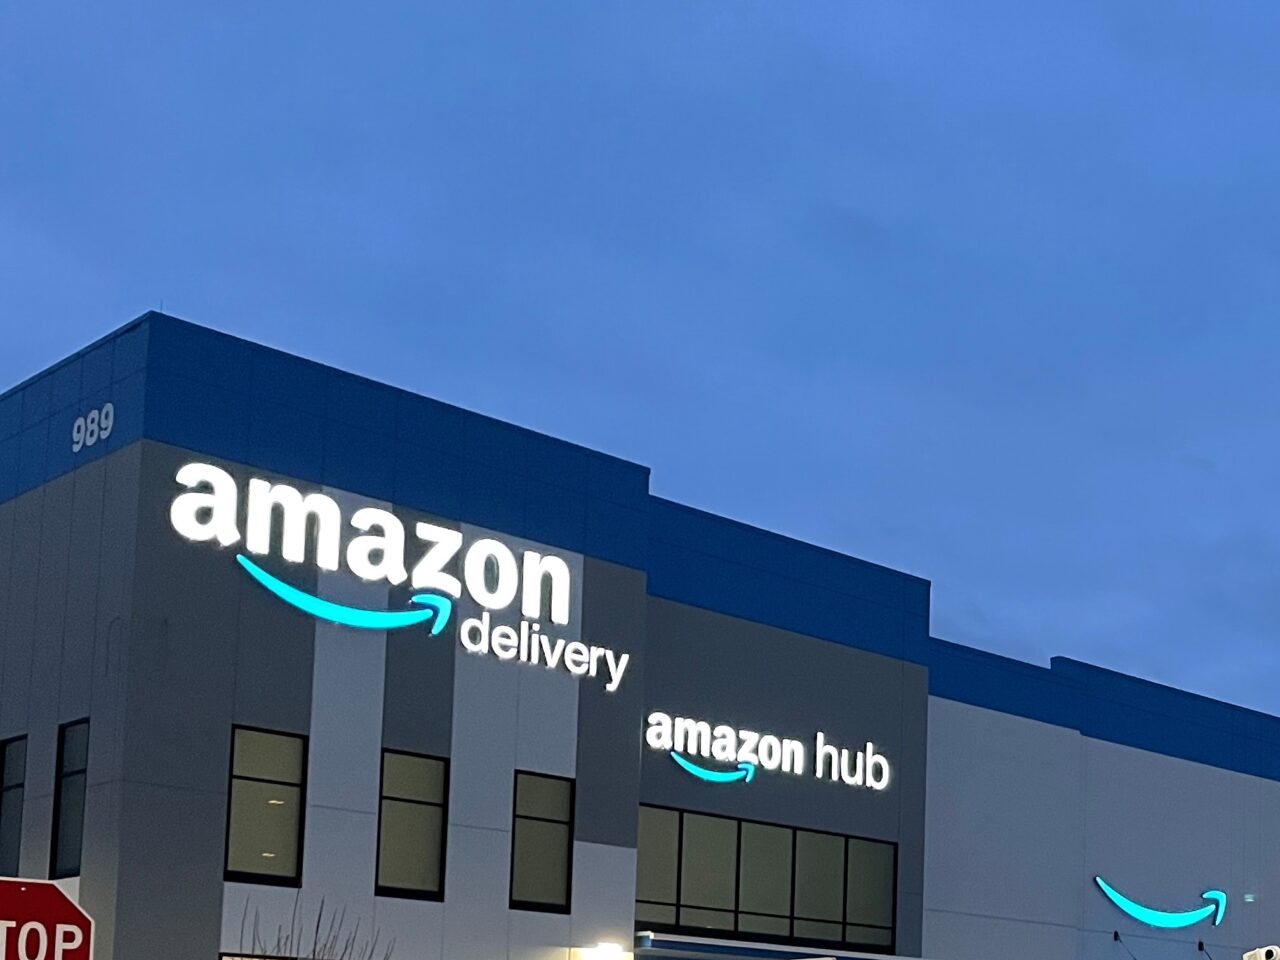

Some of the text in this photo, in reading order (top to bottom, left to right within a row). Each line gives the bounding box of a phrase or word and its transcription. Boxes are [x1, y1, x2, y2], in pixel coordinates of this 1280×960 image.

[72, 402, 114, 453] 989
[170, 461, 571, 625] amazon
[460, 612, 630, 692] delivery
[645, 711, 891, 791] amazon hub
